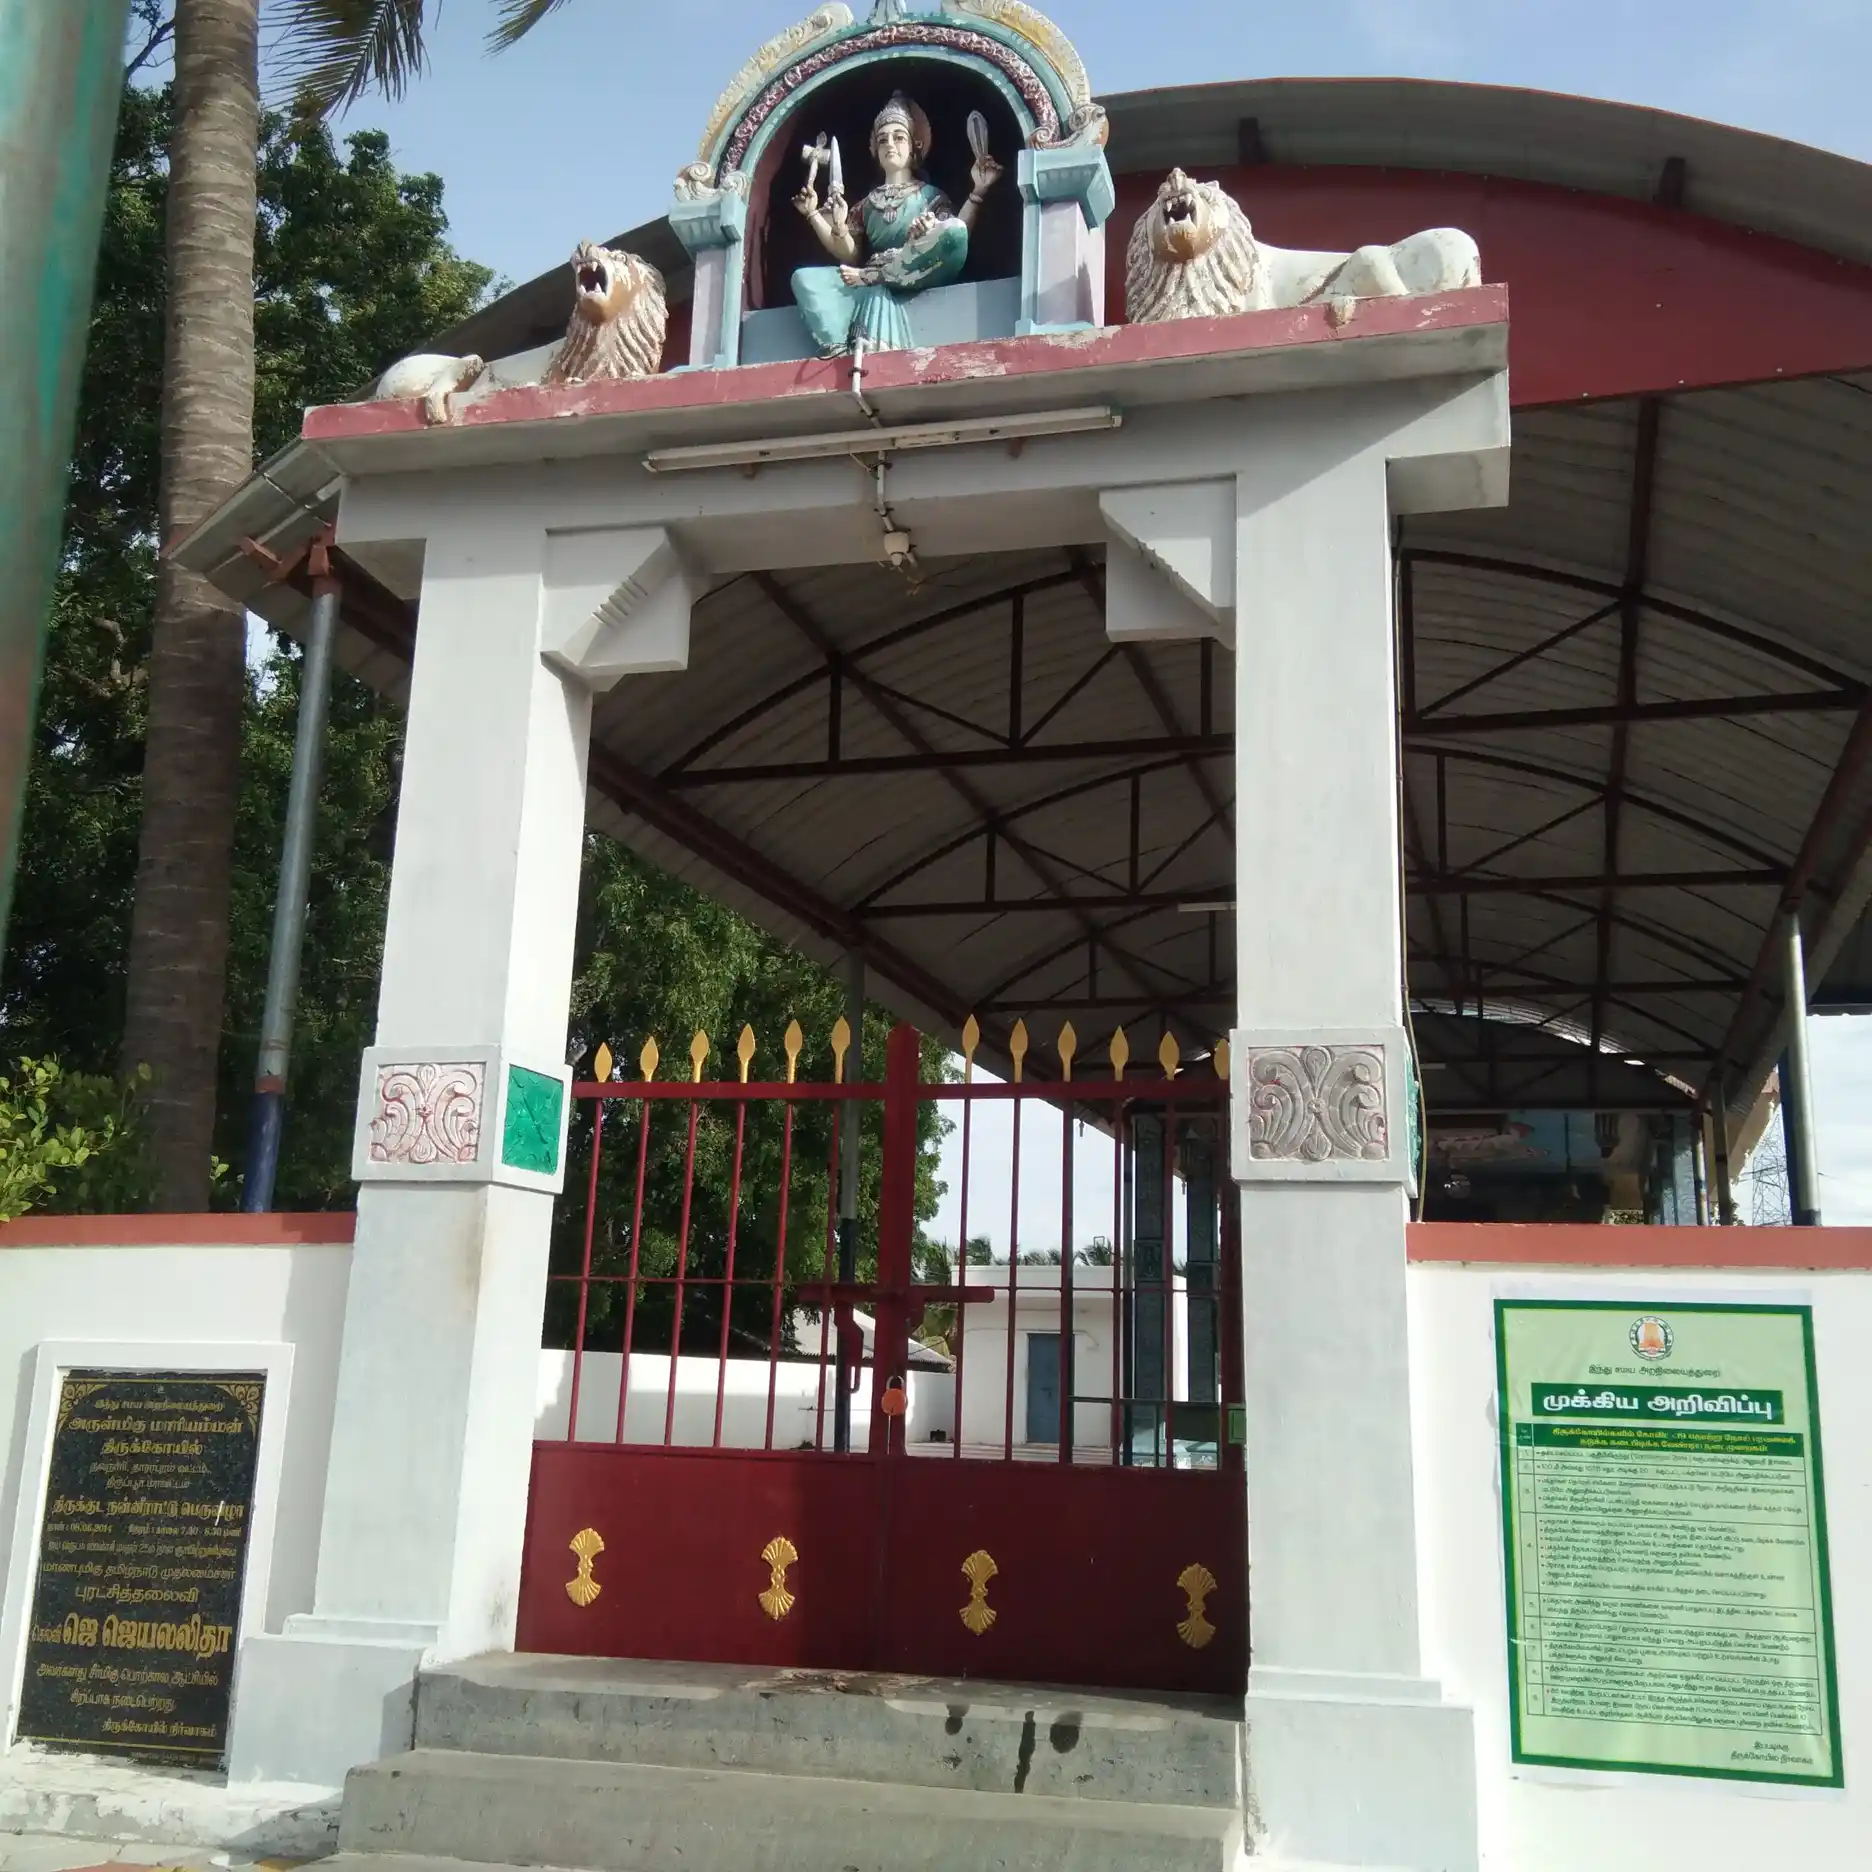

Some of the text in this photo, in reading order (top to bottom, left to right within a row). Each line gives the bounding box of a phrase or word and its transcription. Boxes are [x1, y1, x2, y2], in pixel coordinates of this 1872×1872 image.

[1588, 1364, 1720, 1378] இந்து சமய அறநிலையத்துறை
[1542, 1386, 1772, 1419] முக்கிய அறிவிப்பு
[69, 1415, 243, 1433] அருள்மிகு மாரியம்மன்
[100, 1438, 203, 1456] திருக்கோயில்
[52, 1495, 244, 1521] திருக்குட நன்னீராட்டு பெருவிழா
[42, 1562, 235, 1580] மாண்புமிகு தமிழ்நாடு முதலமைச்சர்
[31, 1624, 61, 1644] செல்வி
[102, 1612, 233, 1661] ஜெயலலிதா
[88, 1663, 119, 1683] சீர்மிகு
[120, 1666, 168, 1685] பொற்கால
[170, 1670, 218, 1687] ஆட்சியில்
[70, 1687, 110, 1707] சிறப்பாக
[101, 1717, 217, 1737] திருக்கோயில் நிர்வாகம்
[1730, 1750, 1778, 1763] திருக்கோயில்
